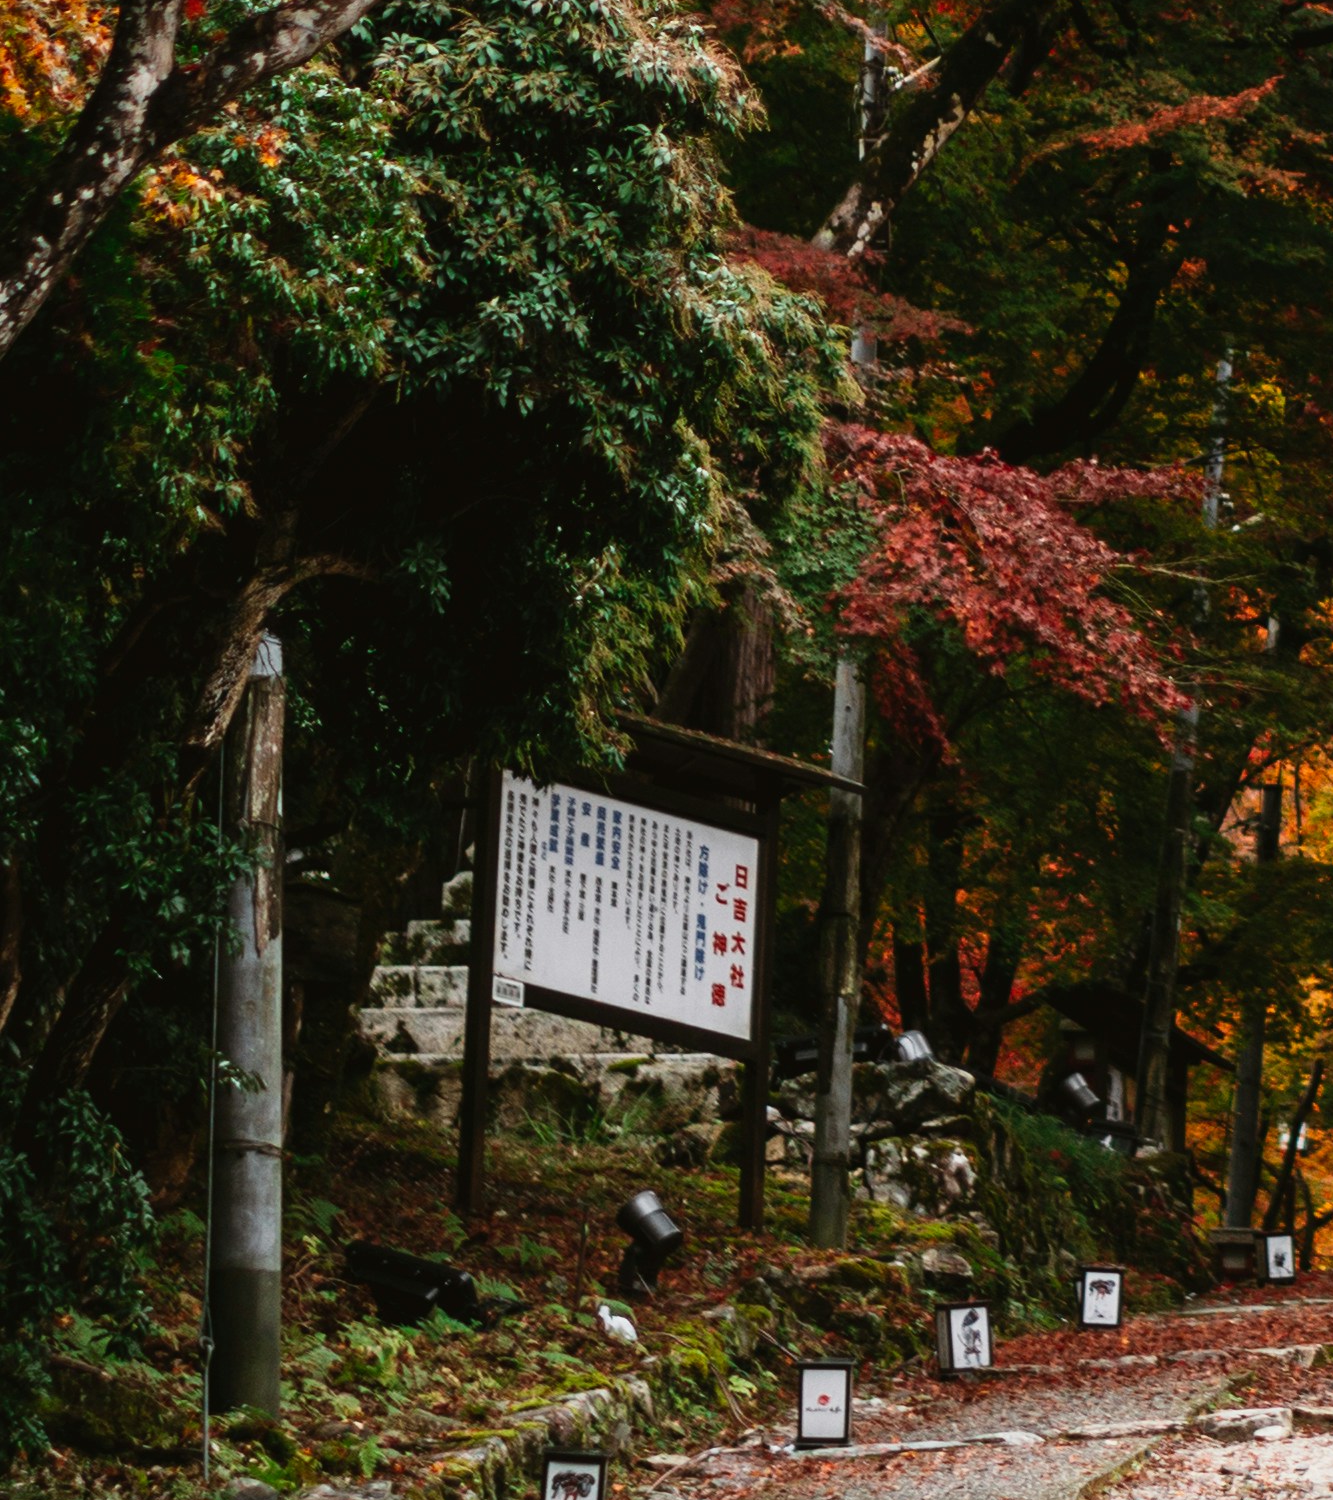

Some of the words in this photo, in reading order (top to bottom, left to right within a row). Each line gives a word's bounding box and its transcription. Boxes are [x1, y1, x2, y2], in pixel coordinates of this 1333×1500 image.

[610, 809, 622, 870] 家内安全
[729, 863, 748, 989] 日吉大社
